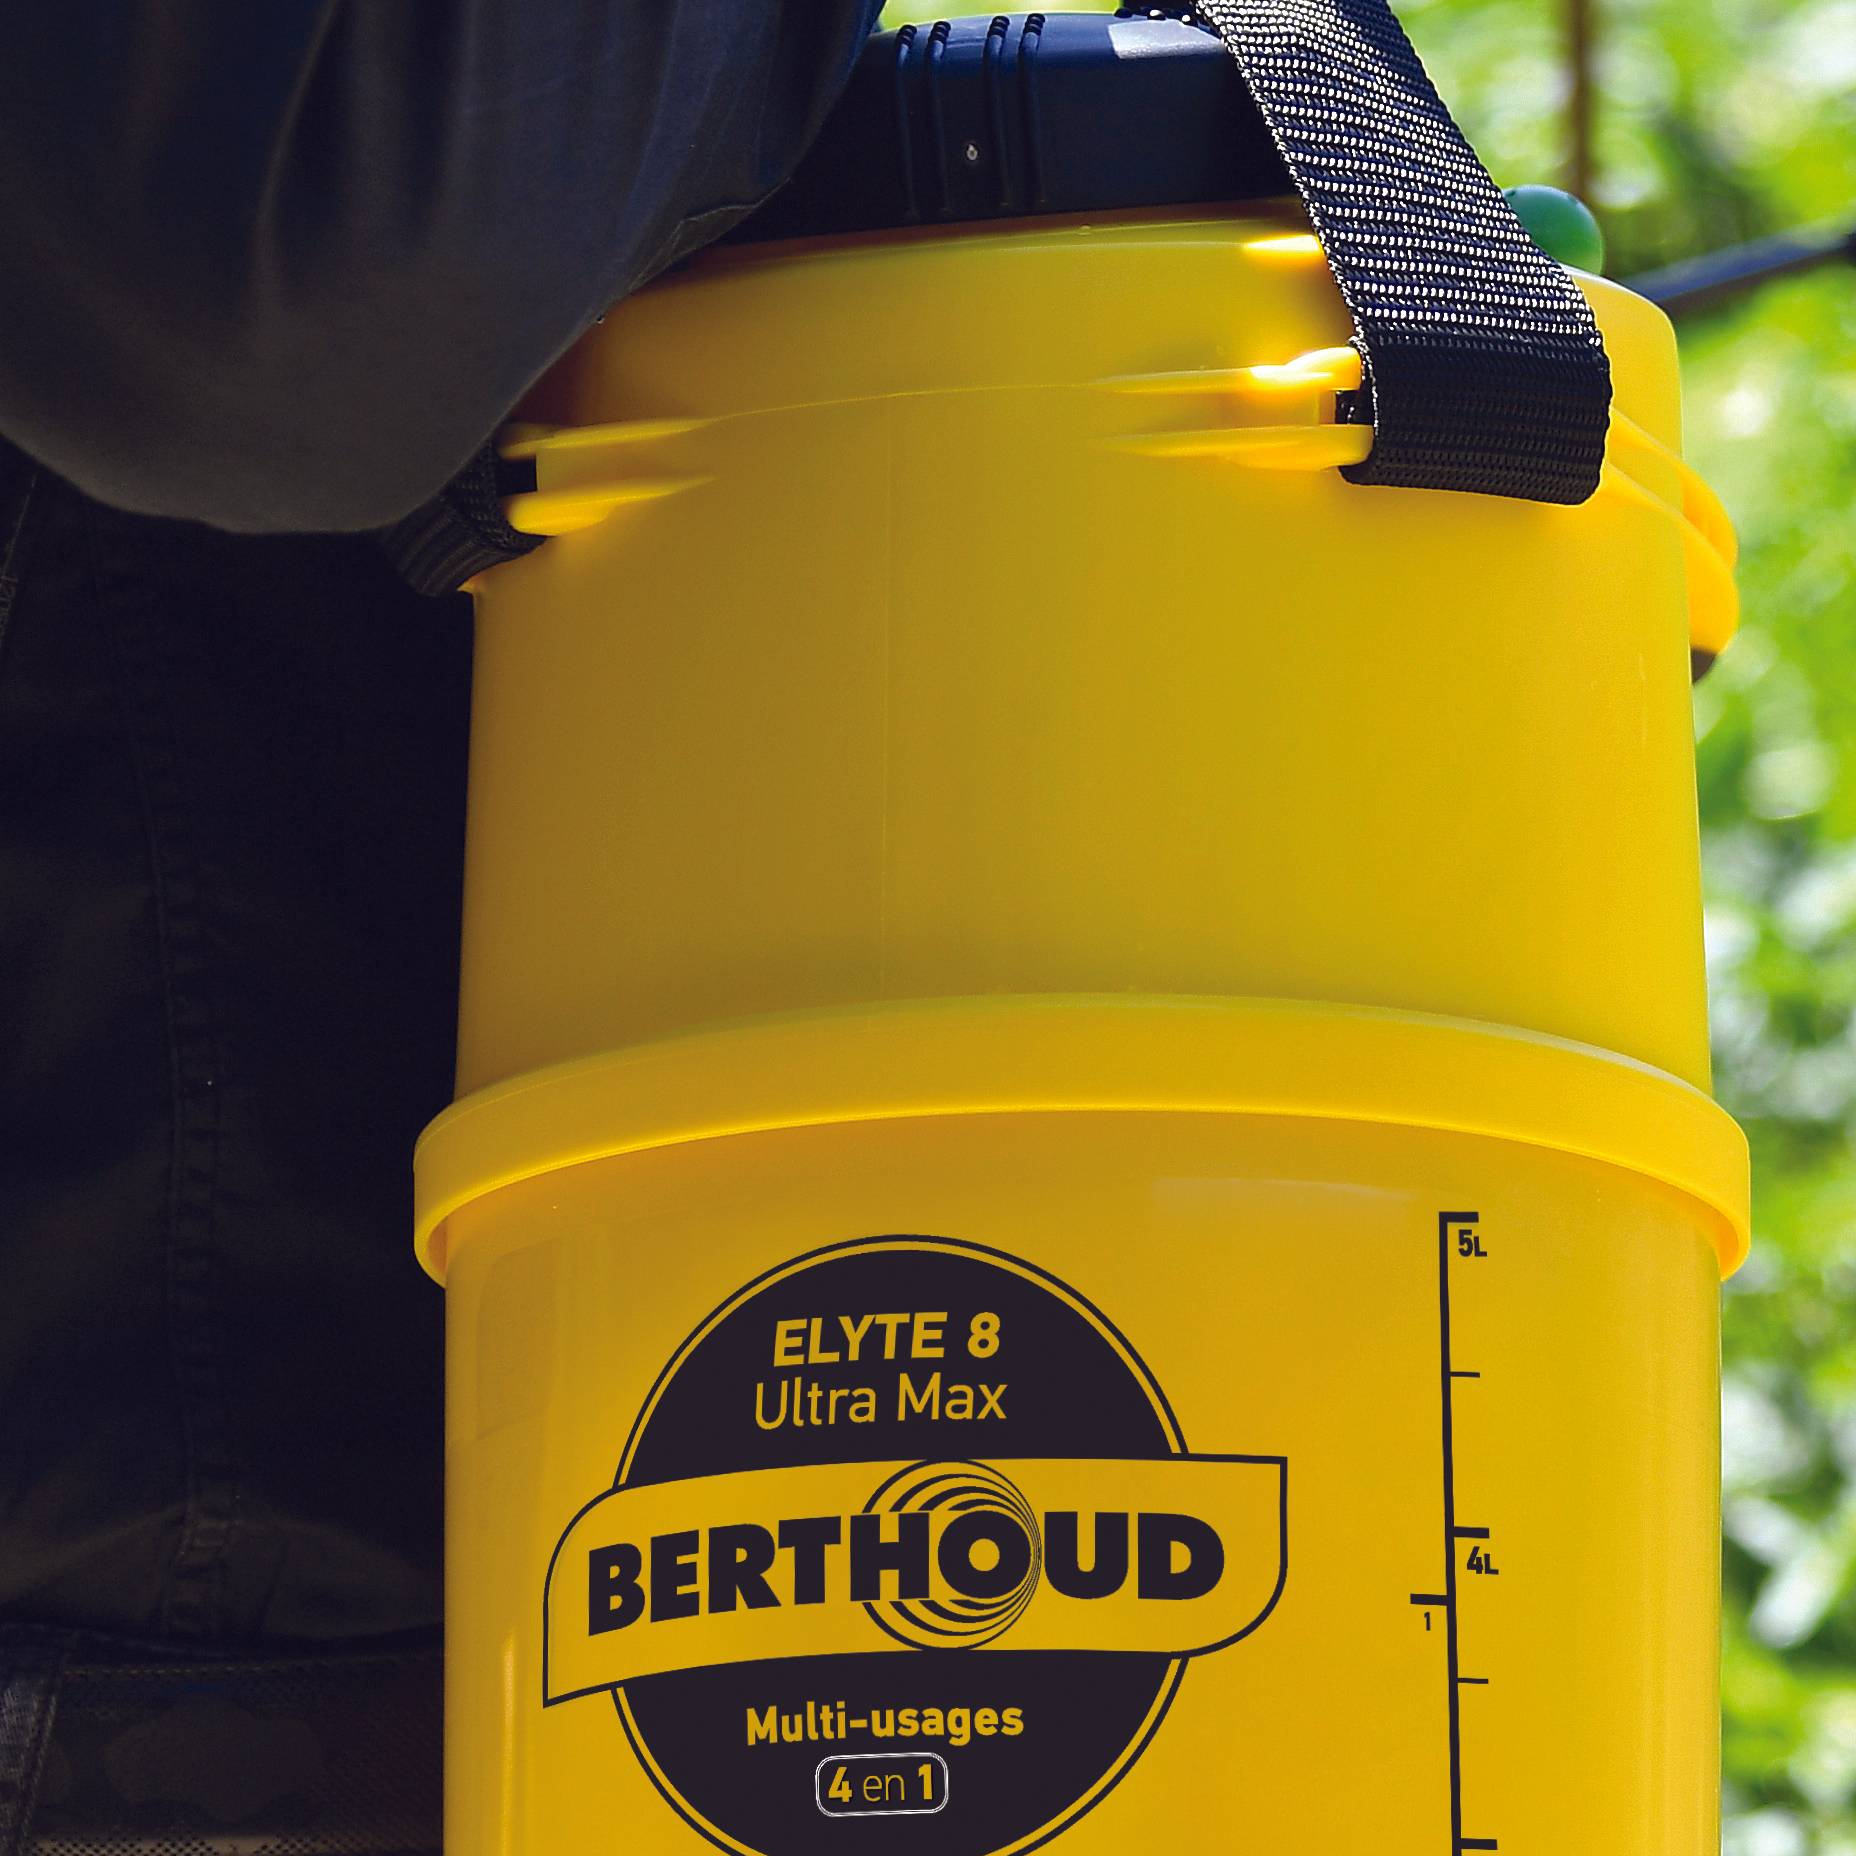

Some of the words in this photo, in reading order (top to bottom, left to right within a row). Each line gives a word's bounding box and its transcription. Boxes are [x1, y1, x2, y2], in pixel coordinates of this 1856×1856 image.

[1457, 1230, 1488, 1258] 5L
[774, 1312, 948, 1367] ELYTE
[968, 1312, 1000, 1358] 8
[755, 1377, 876, 1430] Ultra
[897, 1372, 1008, 1422] Max
[587, 1508, 1225, 1637] BERTHOUD
[1465, 1547, 1499, 1576] 4L
[1422, 1612, 1432, 1631] 1
[746, 1701, 1024, 1746] Multi-usages
[828, 1766, 852, 1802] 4
[863, 1774, 905, 1802] en
[918, 1763, 933, 1800] 1
